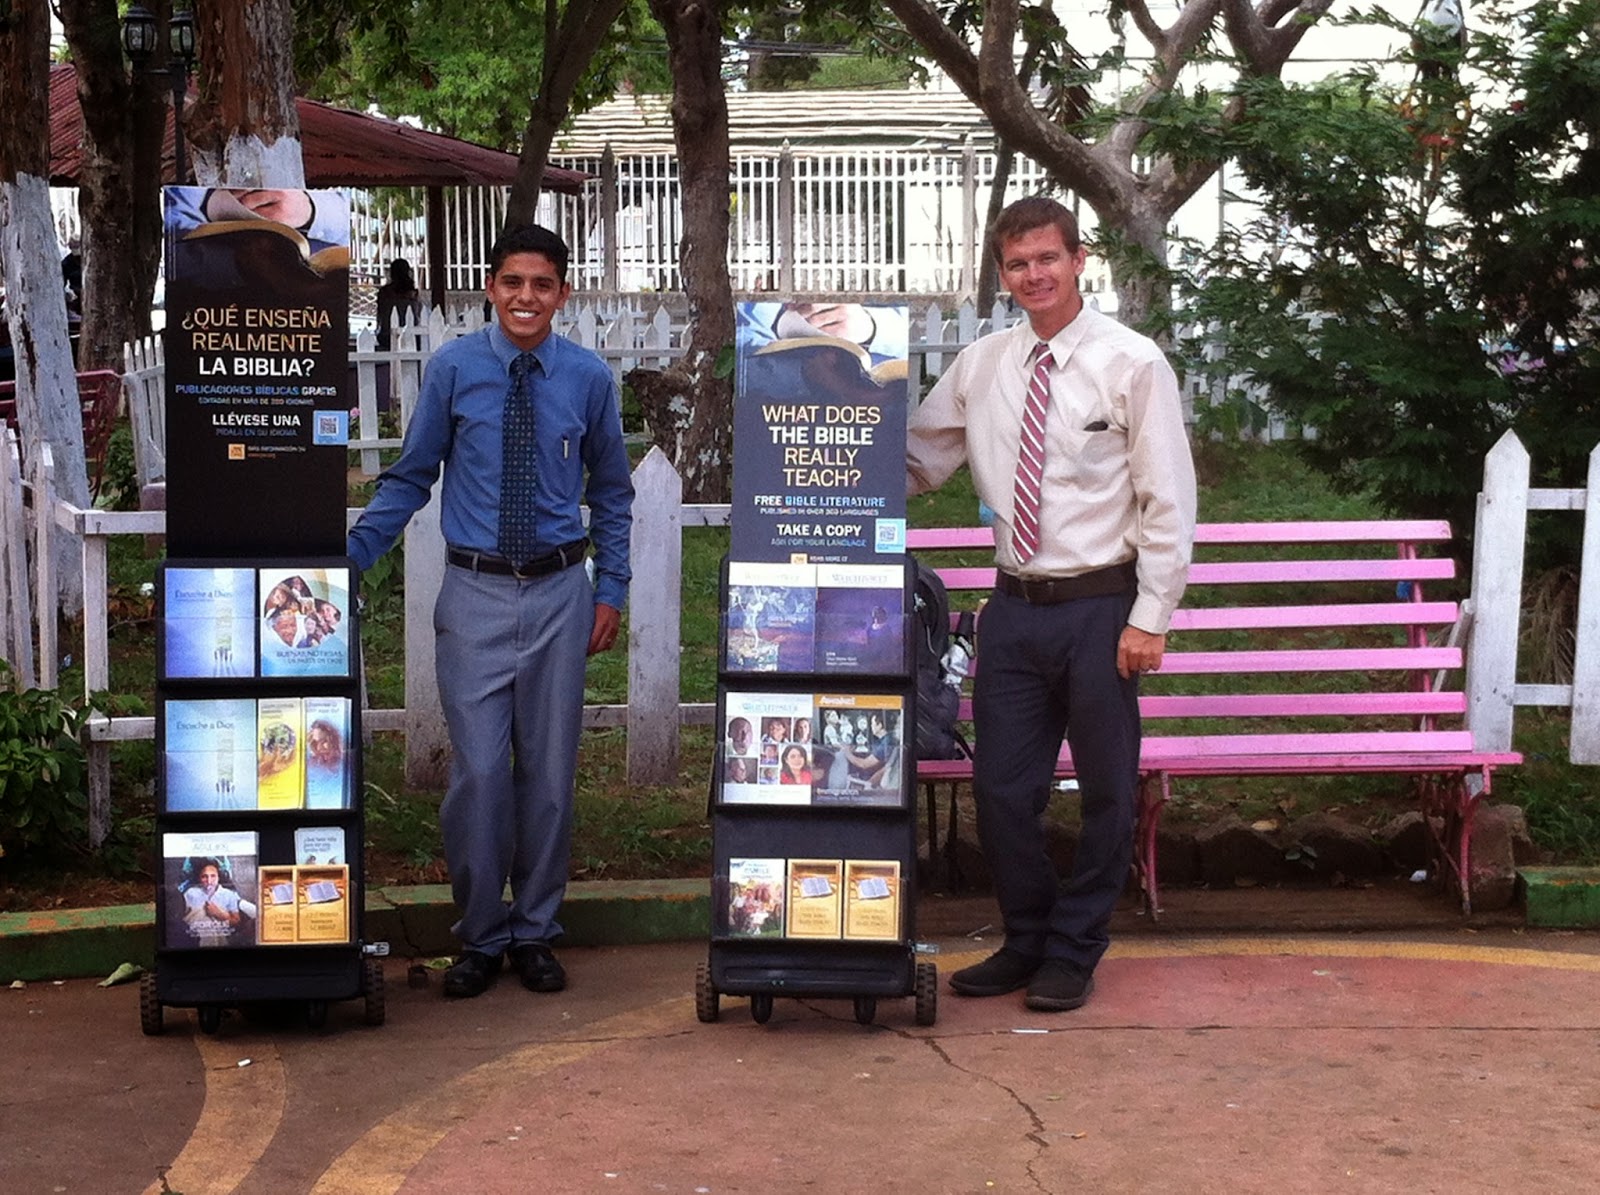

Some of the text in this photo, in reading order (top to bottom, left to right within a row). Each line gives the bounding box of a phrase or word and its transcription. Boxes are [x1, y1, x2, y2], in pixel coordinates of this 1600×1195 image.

[181, 303, 332, 330] ¿QUÉ ENSEÑA
[192, 332, 321, 353] REALMENTE
[199, 357, 315, 377] LA BIBLIA?
[175, 384, 252, 395] PUBLICACIONES
[301, 386, 337, 396] GRATIS
[212, 411, 301, 426] LLÉVESE UNA
[762, 405, 881, 424] WHAT DOES
[769, 426, 874, 445] THE BIBLE
[784, 448, 858, 466] REALLY
[783, 469, 862, 488] TEACH?
[754, 495, 886, 507] FREE BIBLE LITERATURE
[776, 524, 862, 537] TAKE A COPY
[827, 539, 867, 548] LANGUAGE
